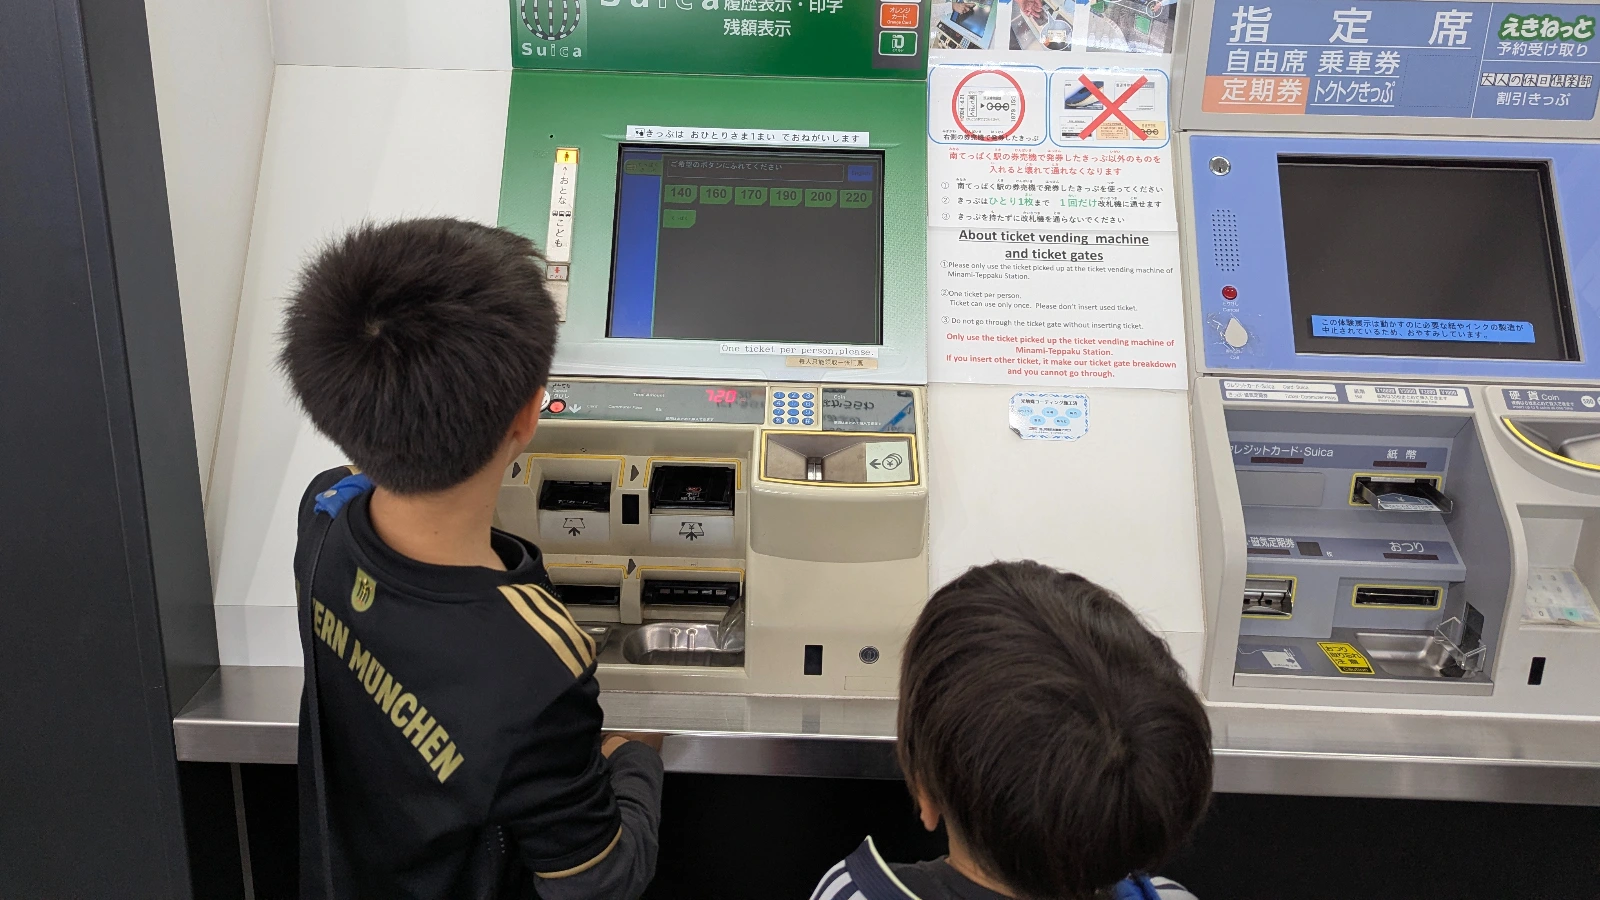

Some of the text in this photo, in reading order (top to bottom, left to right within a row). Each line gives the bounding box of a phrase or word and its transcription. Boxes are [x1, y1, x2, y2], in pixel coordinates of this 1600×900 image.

[723, 18, 792, 37] 残額表示
[1501, 16, 1594, 40] えきねっと
[521, 42, 583, 58] Suica
[1496, 41, 1589, 58] 予約受け取り
[1225, 48, 1400, 75] 自由席 乗車券
[1219, 77, 1396, 105] 定期券 トクトクきっぷ
[1496, 91, 1572, 108] 割引きっぷ
[645, 128, 861, 144] きっぷは おひとりさま1まい でおねがいします
[557, 176, 569, 205] おとな
[670, 188, 867, 203] 140 160 170 190 200 220
[554, 219, 566, 249] こども
[958, 229, 1150, 245] About ticket vending machine
[1004, 248, 1104, 262] and ticket gates
[947, 333, 965, 341] Only
[982, 334, 995, 342] the
[997, 335, 1019, 343] ticket
[1020, 336, 1045, 344] picked
[1060, 337, 1072, 345] the
[1074, 337, 1096, 345] ticket
[1098, 338, 1130, 347] vending
[1131, 339, 1165, 347] machine
[721, 344, 741, 353] One
[744, 345, 776, 353] ticket
[780, 347, 797, 355] per
[1015, 347, 1114, 357] Minami-Teppaku Station.
[946, 354, 953, 362] If
[970, 355, 993, 363] insert
[994, 356, 1016, 364] other
[1017, 358, 1042, 366] ticket,
[1089, 359, 1112, 367] ticket
[1113, 361, 1131, 369] gate
[1132, 360, 1178, 369] breakdown
[1041, 369, 1068, 377] cannot
[1081, 370, 1115, 379] through.
[705, 389, 737, 403] 720
[1386, 449, 1418, 461] 紙幣
[1388, 541, 1425, 553] おつり
[312, 598, 350, 660] ERN
